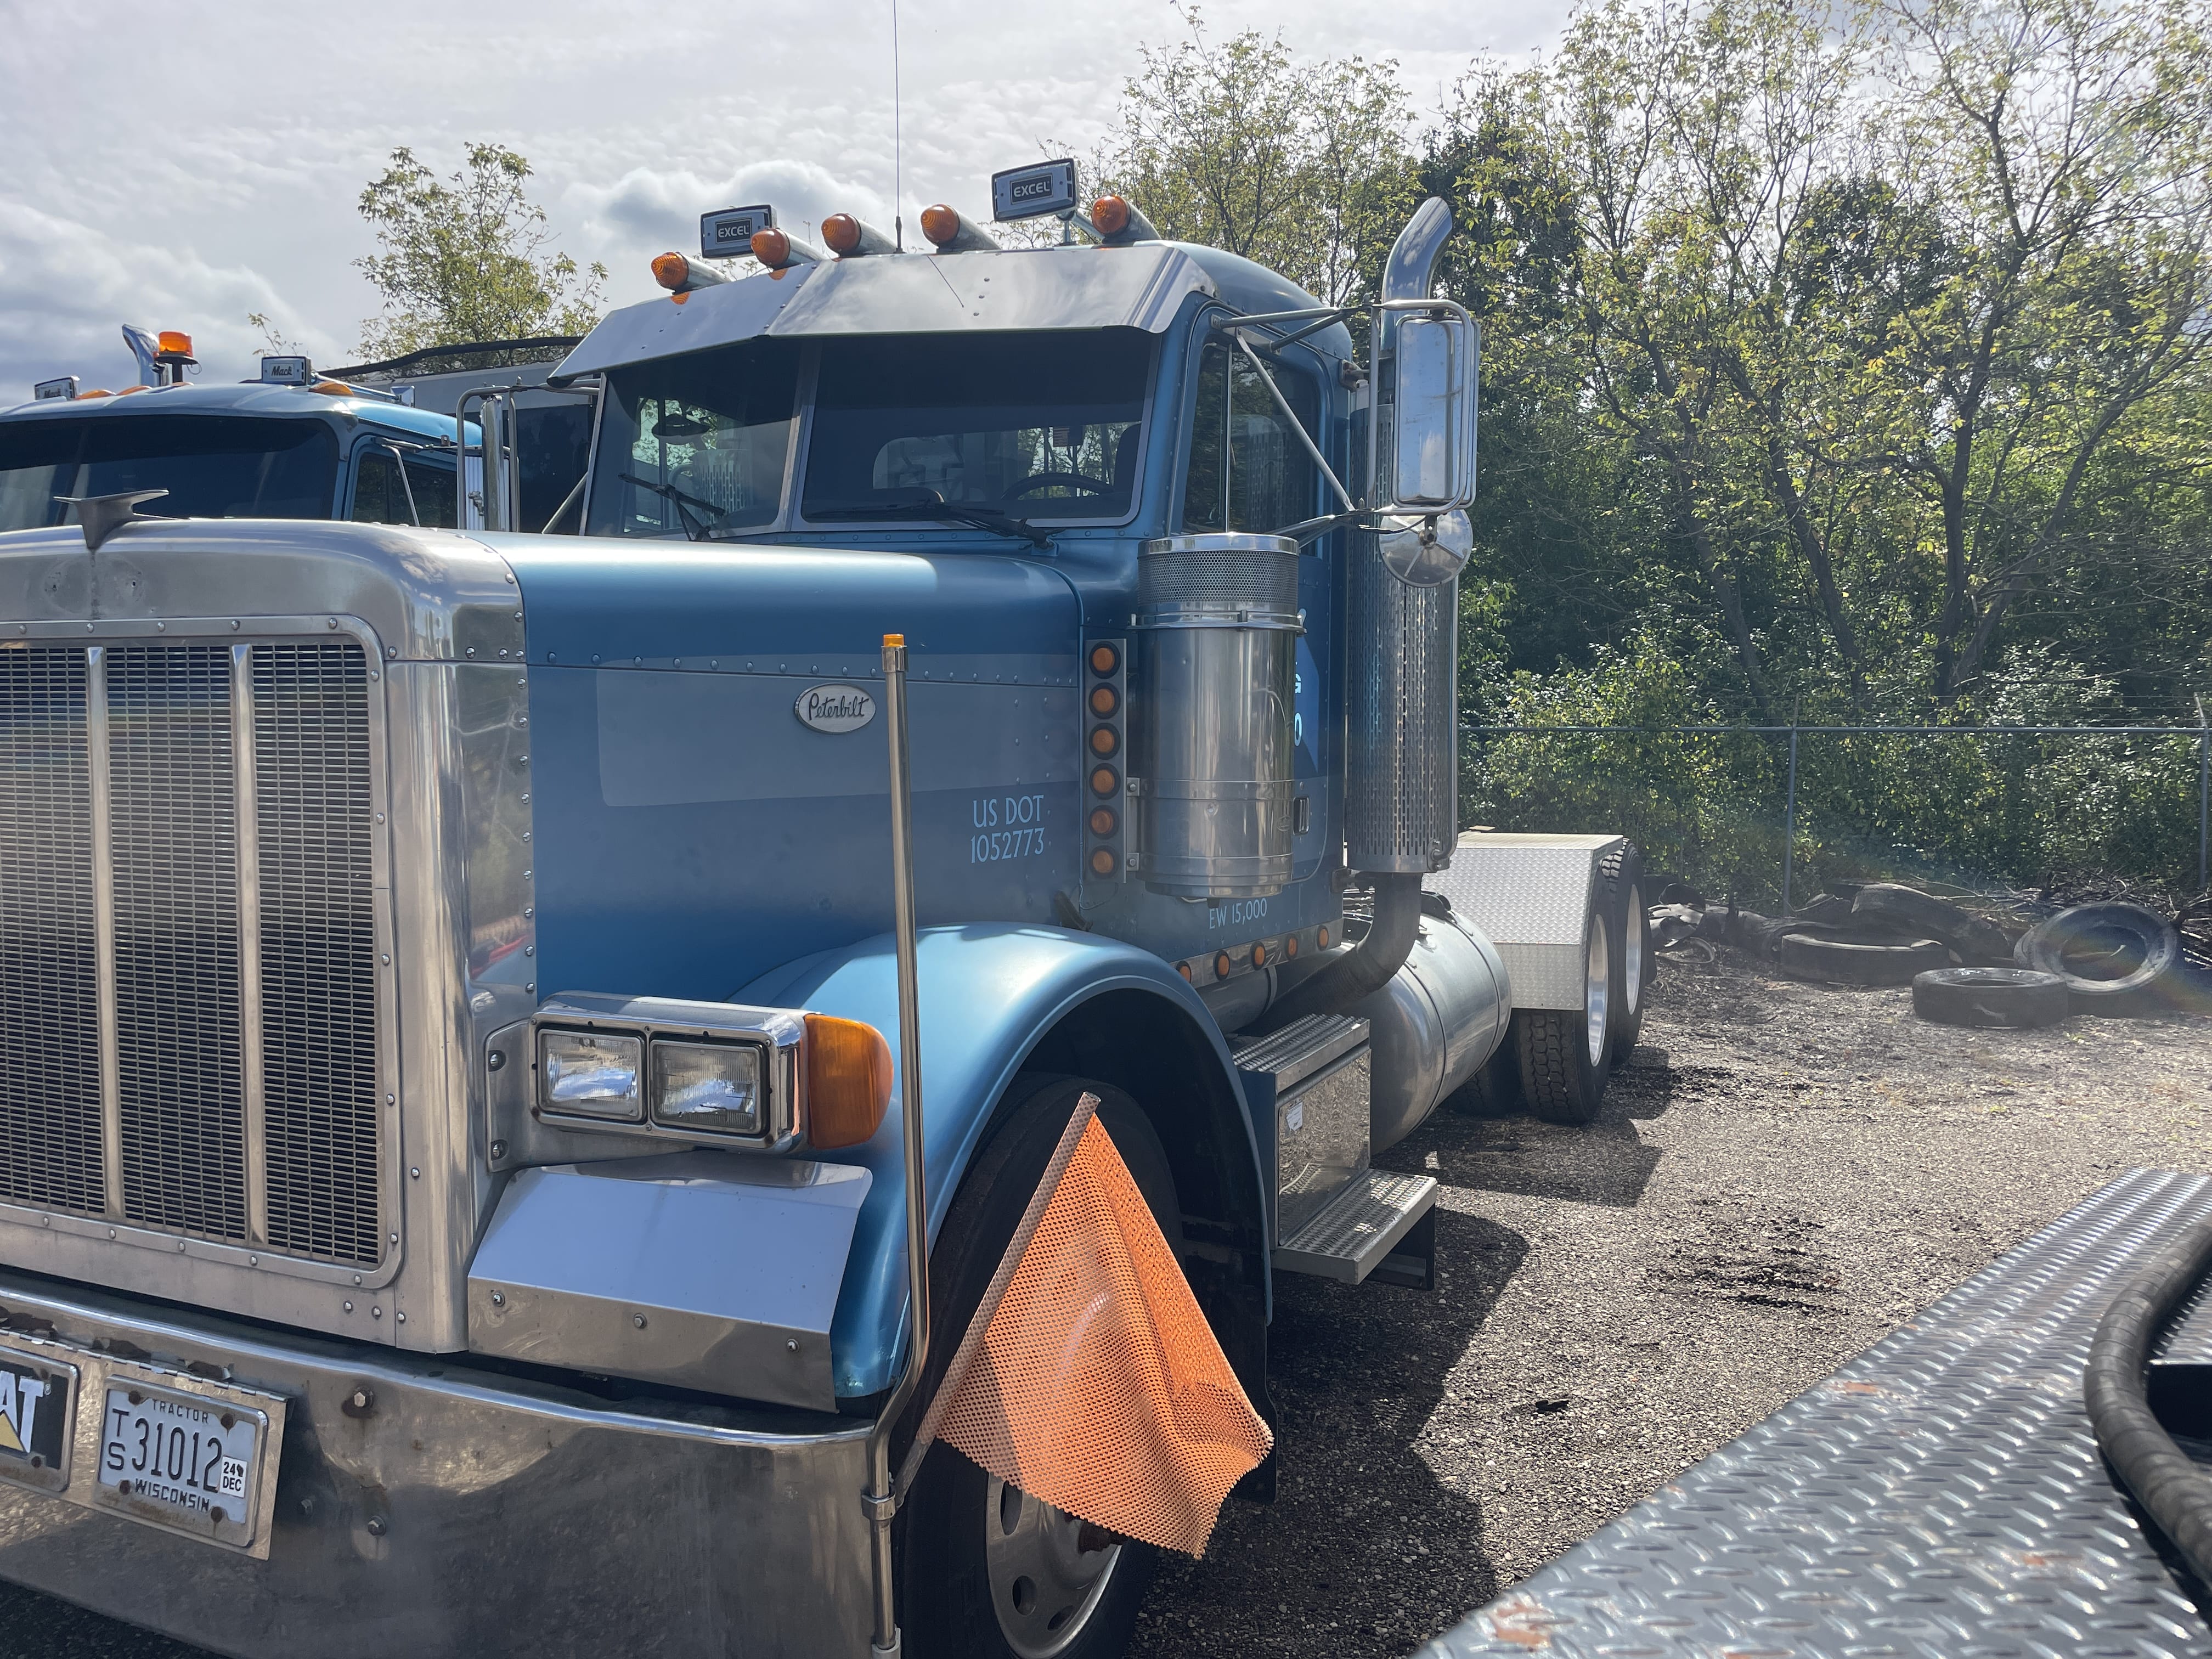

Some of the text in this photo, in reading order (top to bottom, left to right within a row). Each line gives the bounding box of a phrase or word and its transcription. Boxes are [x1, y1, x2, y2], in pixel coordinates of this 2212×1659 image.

[1013, 181, 1050, 198] EXCEL
[718, 225, 749, 238] EXCEL
[271, 365, 292, 376] Mack
[808, 692, 870, 720] Peterbilt
[973, 794, 1044, 828] US DOT
[970, 827, 1045, 864] 1052773
[1209, 898, 1267, 929] EW 15,000
[152, 1398, 209, 1424] TRACTOR
[132, 1418, 222, 1493] 31012
[223, 1462, 236, 1476] 24
[135, 1479, 210, 1512] WISCONSIN
[223, 1476, 242, 1492] DEC
